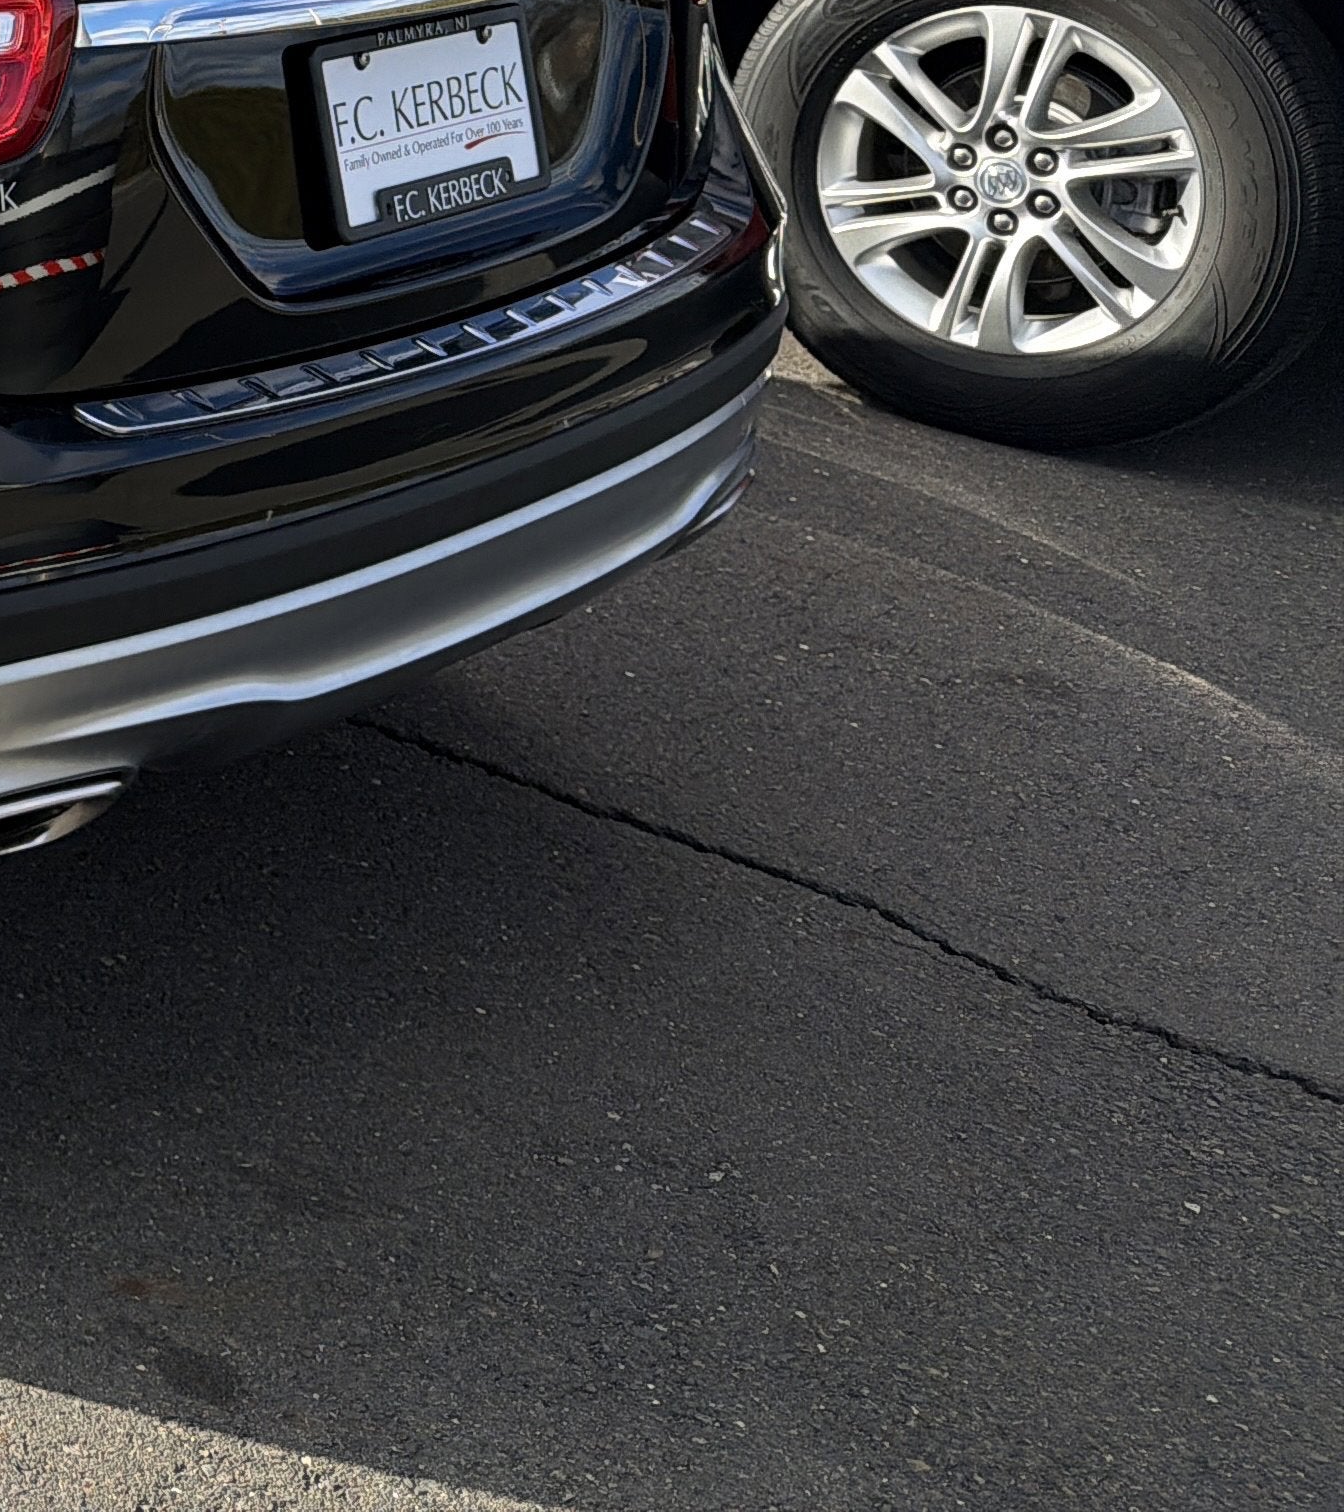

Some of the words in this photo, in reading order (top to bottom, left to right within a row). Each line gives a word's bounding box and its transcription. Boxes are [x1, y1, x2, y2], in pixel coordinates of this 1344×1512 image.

[377, 20, 449, 47] PALMYRA,
[454, 15, 471, 32] NJ
[332, 95, 385, 147] F.C.
[391, 62, 524, 133] KERBECK
[343, 152, 371, 172] Family
[372, 145, 403, 165] Owned
[403, 143, 411, 157] &
[412, 132, 450, 155] Operated
[450, 130, 464, 146] For
[465, 127, 485, 141] Over
[486, 120, 501, 135] 100
[502, 117, 524, 133] Years
[393, 190, 426, 223] F.C.
[427, 168, 507, 213] KERBECK
